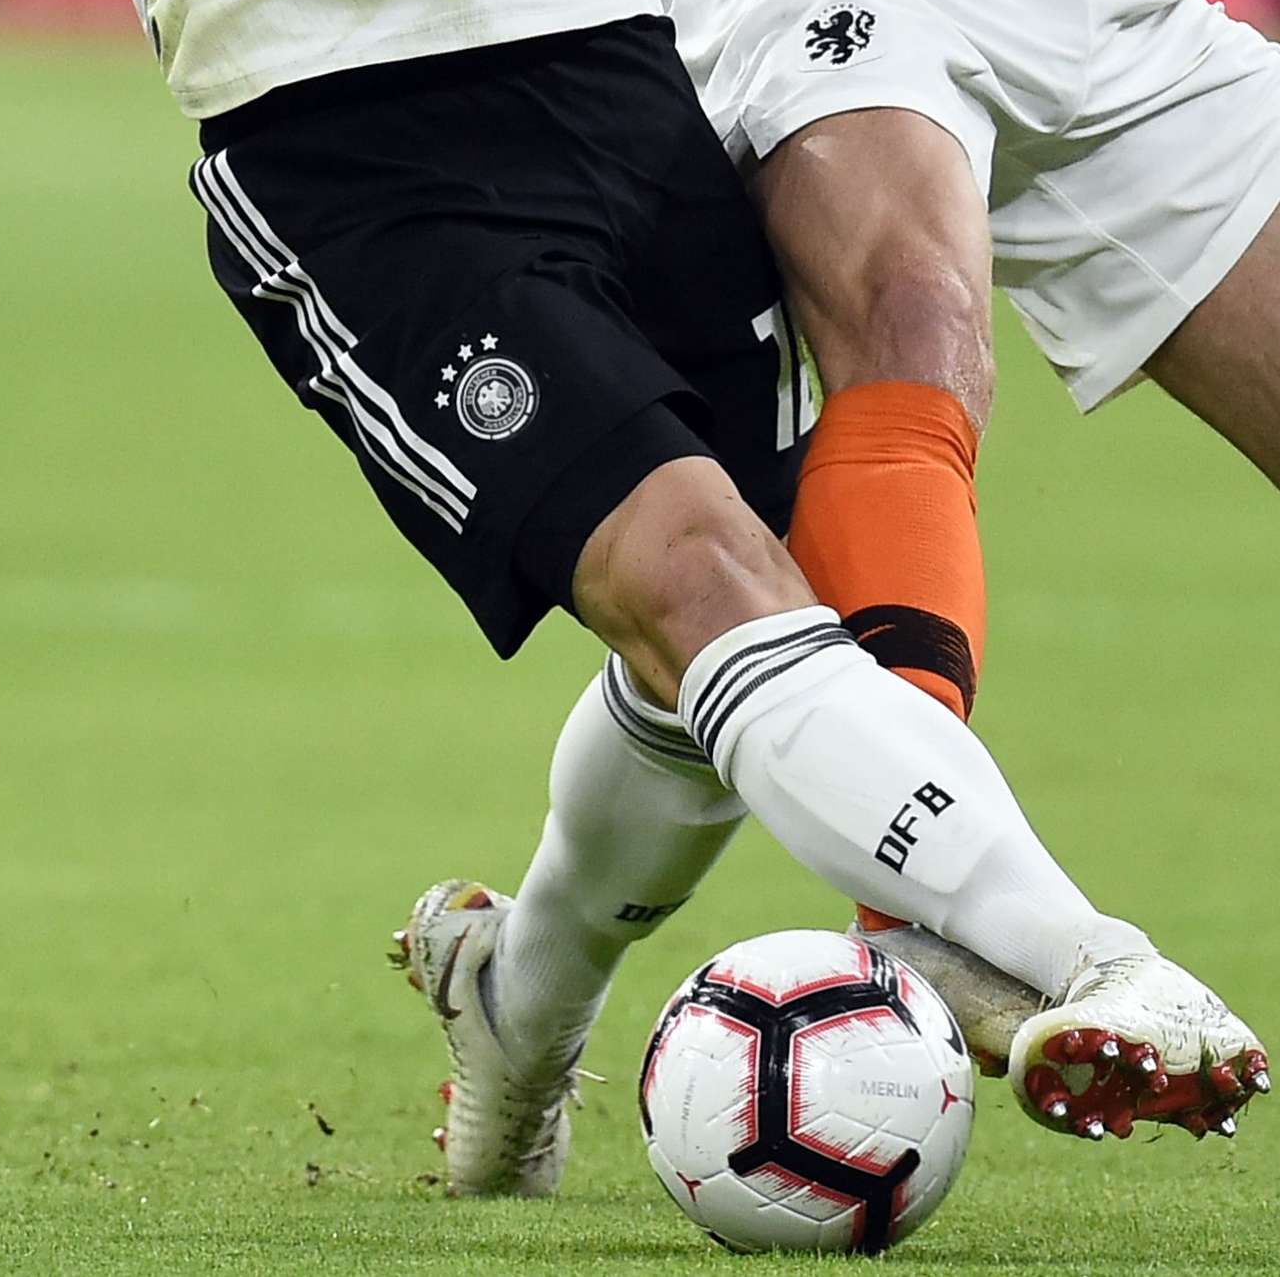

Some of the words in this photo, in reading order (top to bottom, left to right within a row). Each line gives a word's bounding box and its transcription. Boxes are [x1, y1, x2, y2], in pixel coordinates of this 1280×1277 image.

[751, 300, 825, 452] 1
[874, 781, 956, 874] DFB
[860, 1080, 919, 1100] MERLIN
